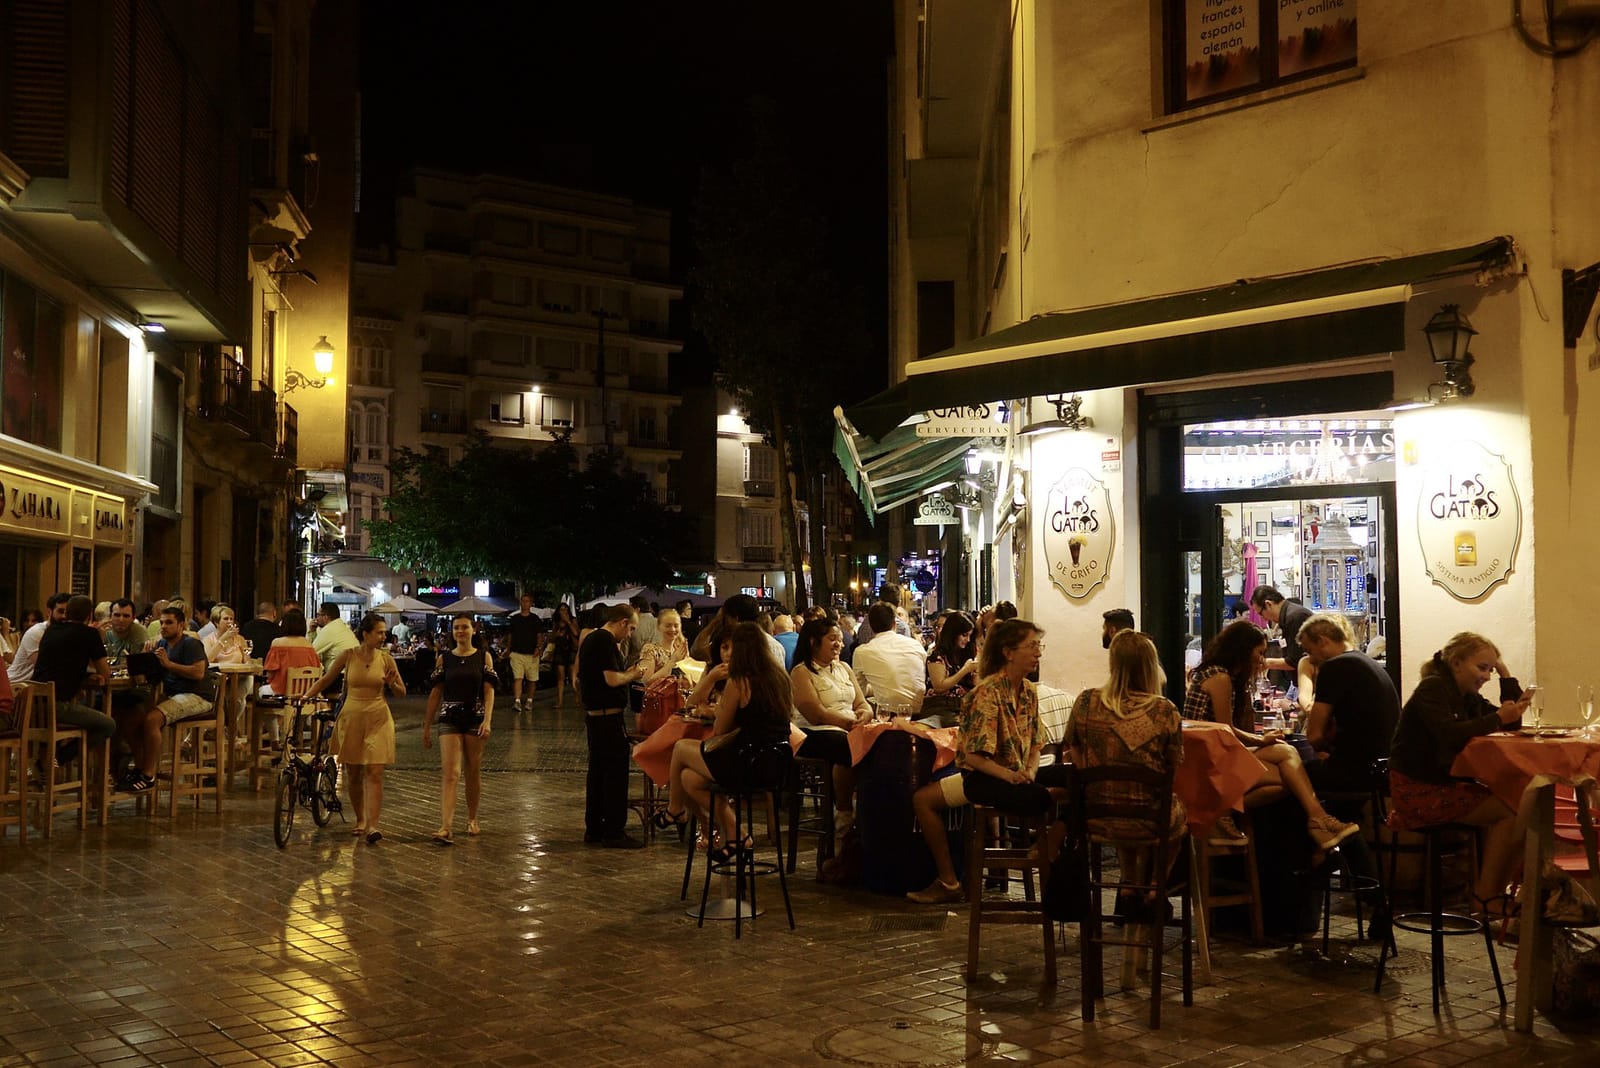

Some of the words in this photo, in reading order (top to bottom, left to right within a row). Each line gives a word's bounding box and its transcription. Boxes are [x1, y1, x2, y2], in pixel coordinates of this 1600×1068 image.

[1202, 5, 1242, 24] francés
[1296, 10, 1303, 22] y
[1307, 0, 1345, 16] online
[1200, 16, 1245, 40] español
[1202, 37, 1243, 55] alemán
[1449, 473, 1485, 497] LOS
[10, 487, 60, 520] ZAHARA
[1064, 495, 1090, 515] LOS
[1430, 491, 1499, 520] GATOS
[95, 509, 123, 530] ZAHARA
[1052, 509, 1100, 533] GATOS
[1056, 561, 1068, 576] DE
[1070, 560, 1098, 580] GRIFO
[1436, 561, 1465, 584] SISTEMA
[1468, 558, 1500, 584] ANTIGUO
